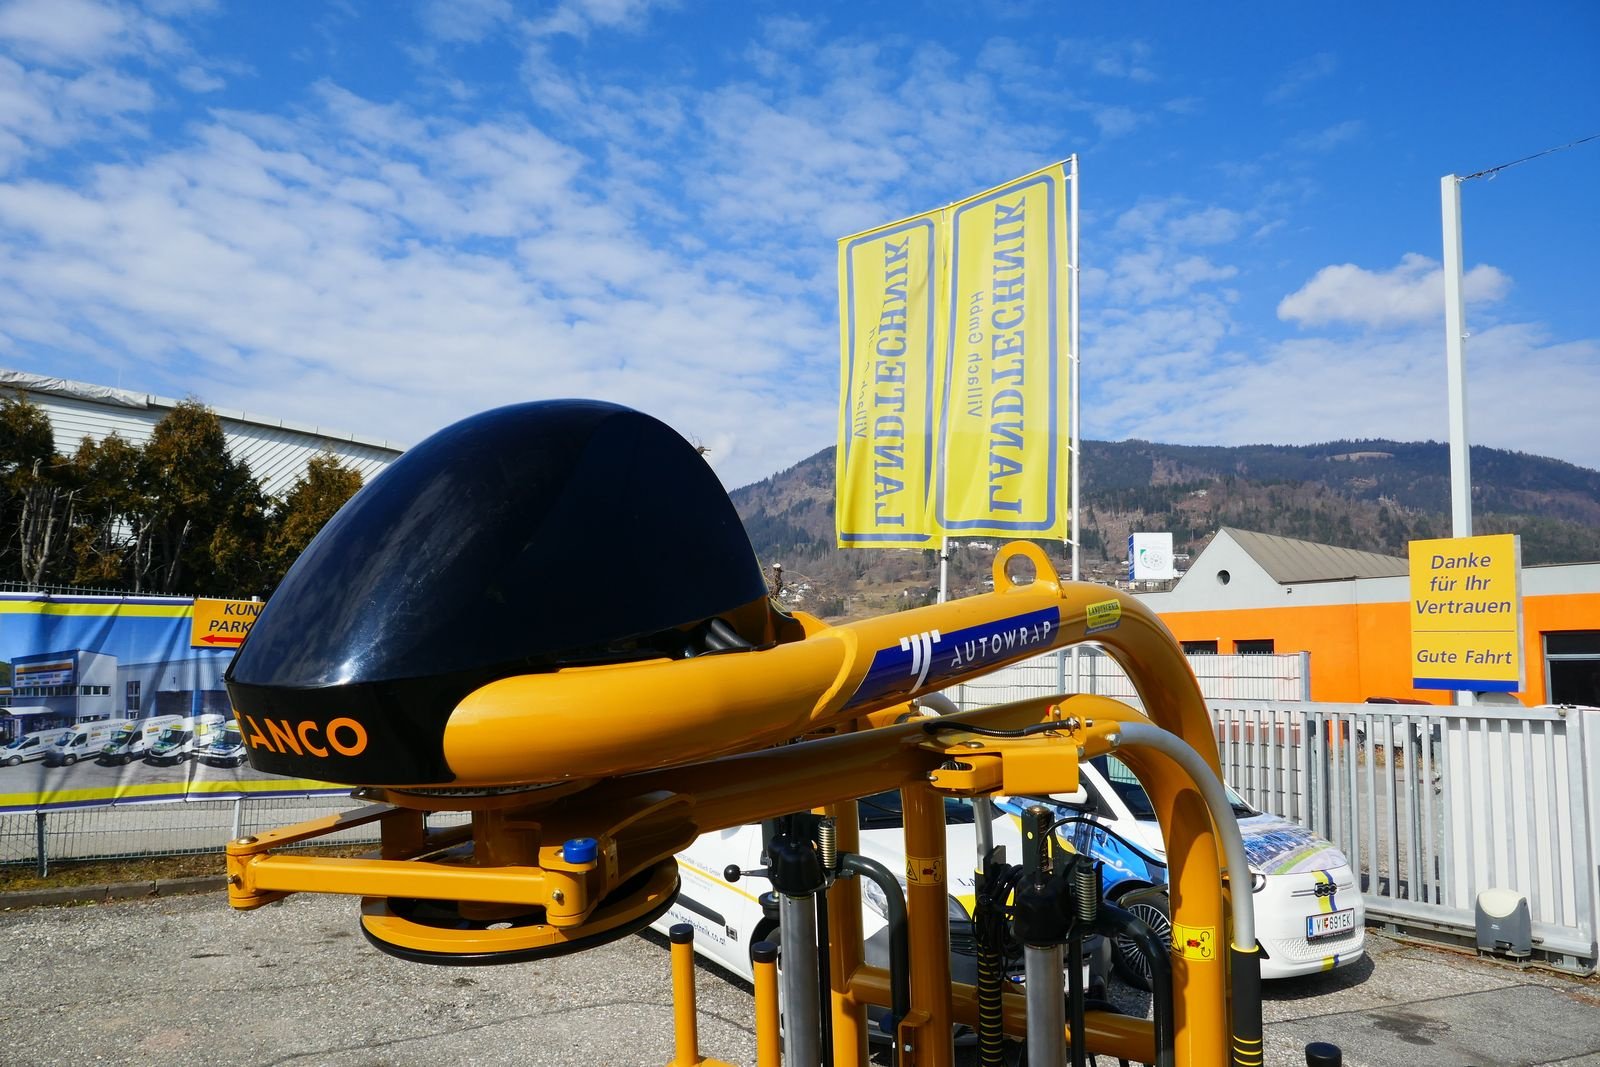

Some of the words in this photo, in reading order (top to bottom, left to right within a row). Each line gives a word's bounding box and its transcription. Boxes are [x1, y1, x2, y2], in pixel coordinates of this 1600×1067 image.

[1431, 552, 1492, 569] Danke
[1430, 575, 1458, 592] für
[1465, 574, 1491, 591] Ihr
[224, 603, 264, 616] KUN
[1415, 600, 1512, 614] Vertrauen
[950, 620, 1051, 668] AUTOWRAP
[1416, 649, 1458, 664] Gute
[1465, 649, 1513, 665] Fahrt
